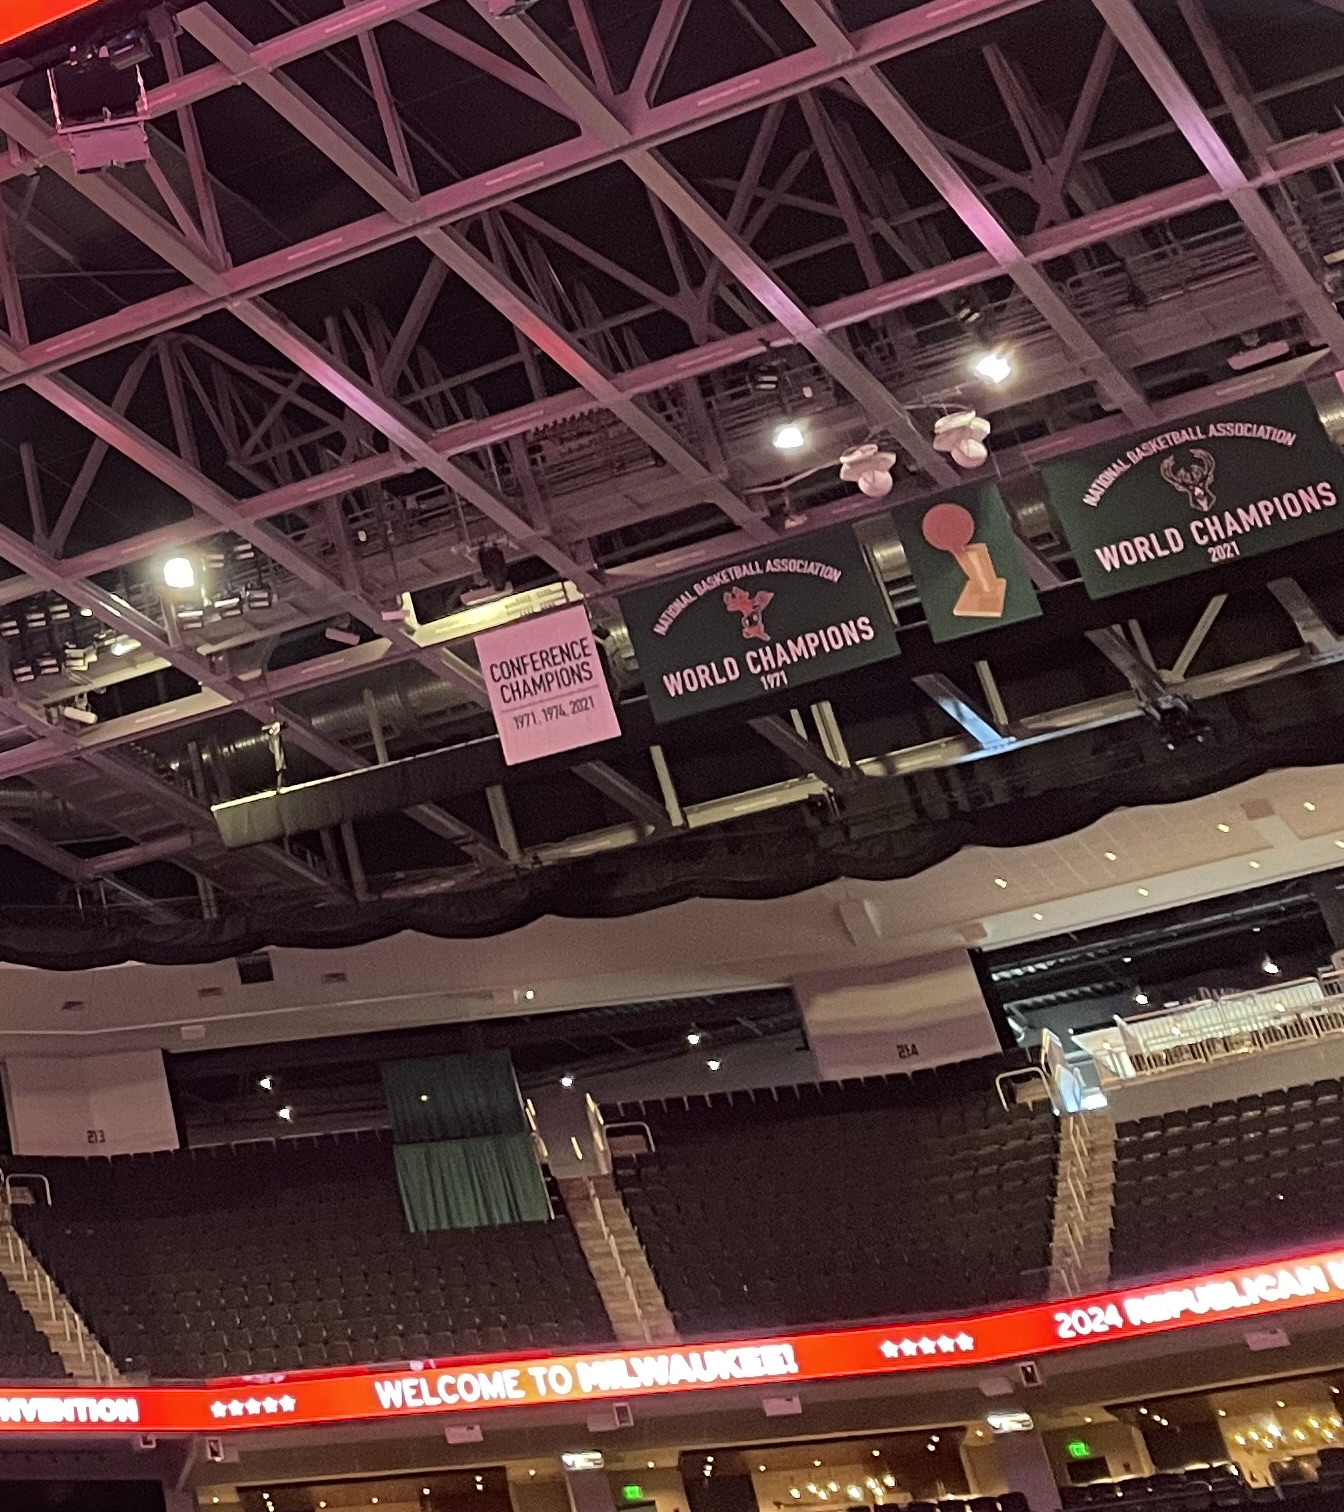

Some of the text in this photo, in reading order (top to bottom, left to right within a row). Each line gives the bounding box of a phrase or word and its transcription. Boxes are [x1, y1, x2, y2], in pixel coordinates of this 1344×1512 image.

[1082, 421, 1296, 507] NATIONAL BASKETBALL ASSOCIATION
[1094, 481, 1338, 573] WORLD CHAMPIONS
[1207, 540, 1240, 563] 2021
[653, 558, 842, 636] NATIONAL BASKETBALL ASSOCIATION
[489, 636, 592, 683] CONFERENCE
[500, 661, 593, 704] CHAMPIONS
[663, 616, 875, 698] WORLD CHAMPIONS
[760, 670, 788, 690] 1971
[1054, 1304, 1124, 1339] 2024
[1124, 1264, 1330, 1326] REPUBLICAN
[374, 1343, 799, 1409] WELCOME TO MILWAUKEE!
